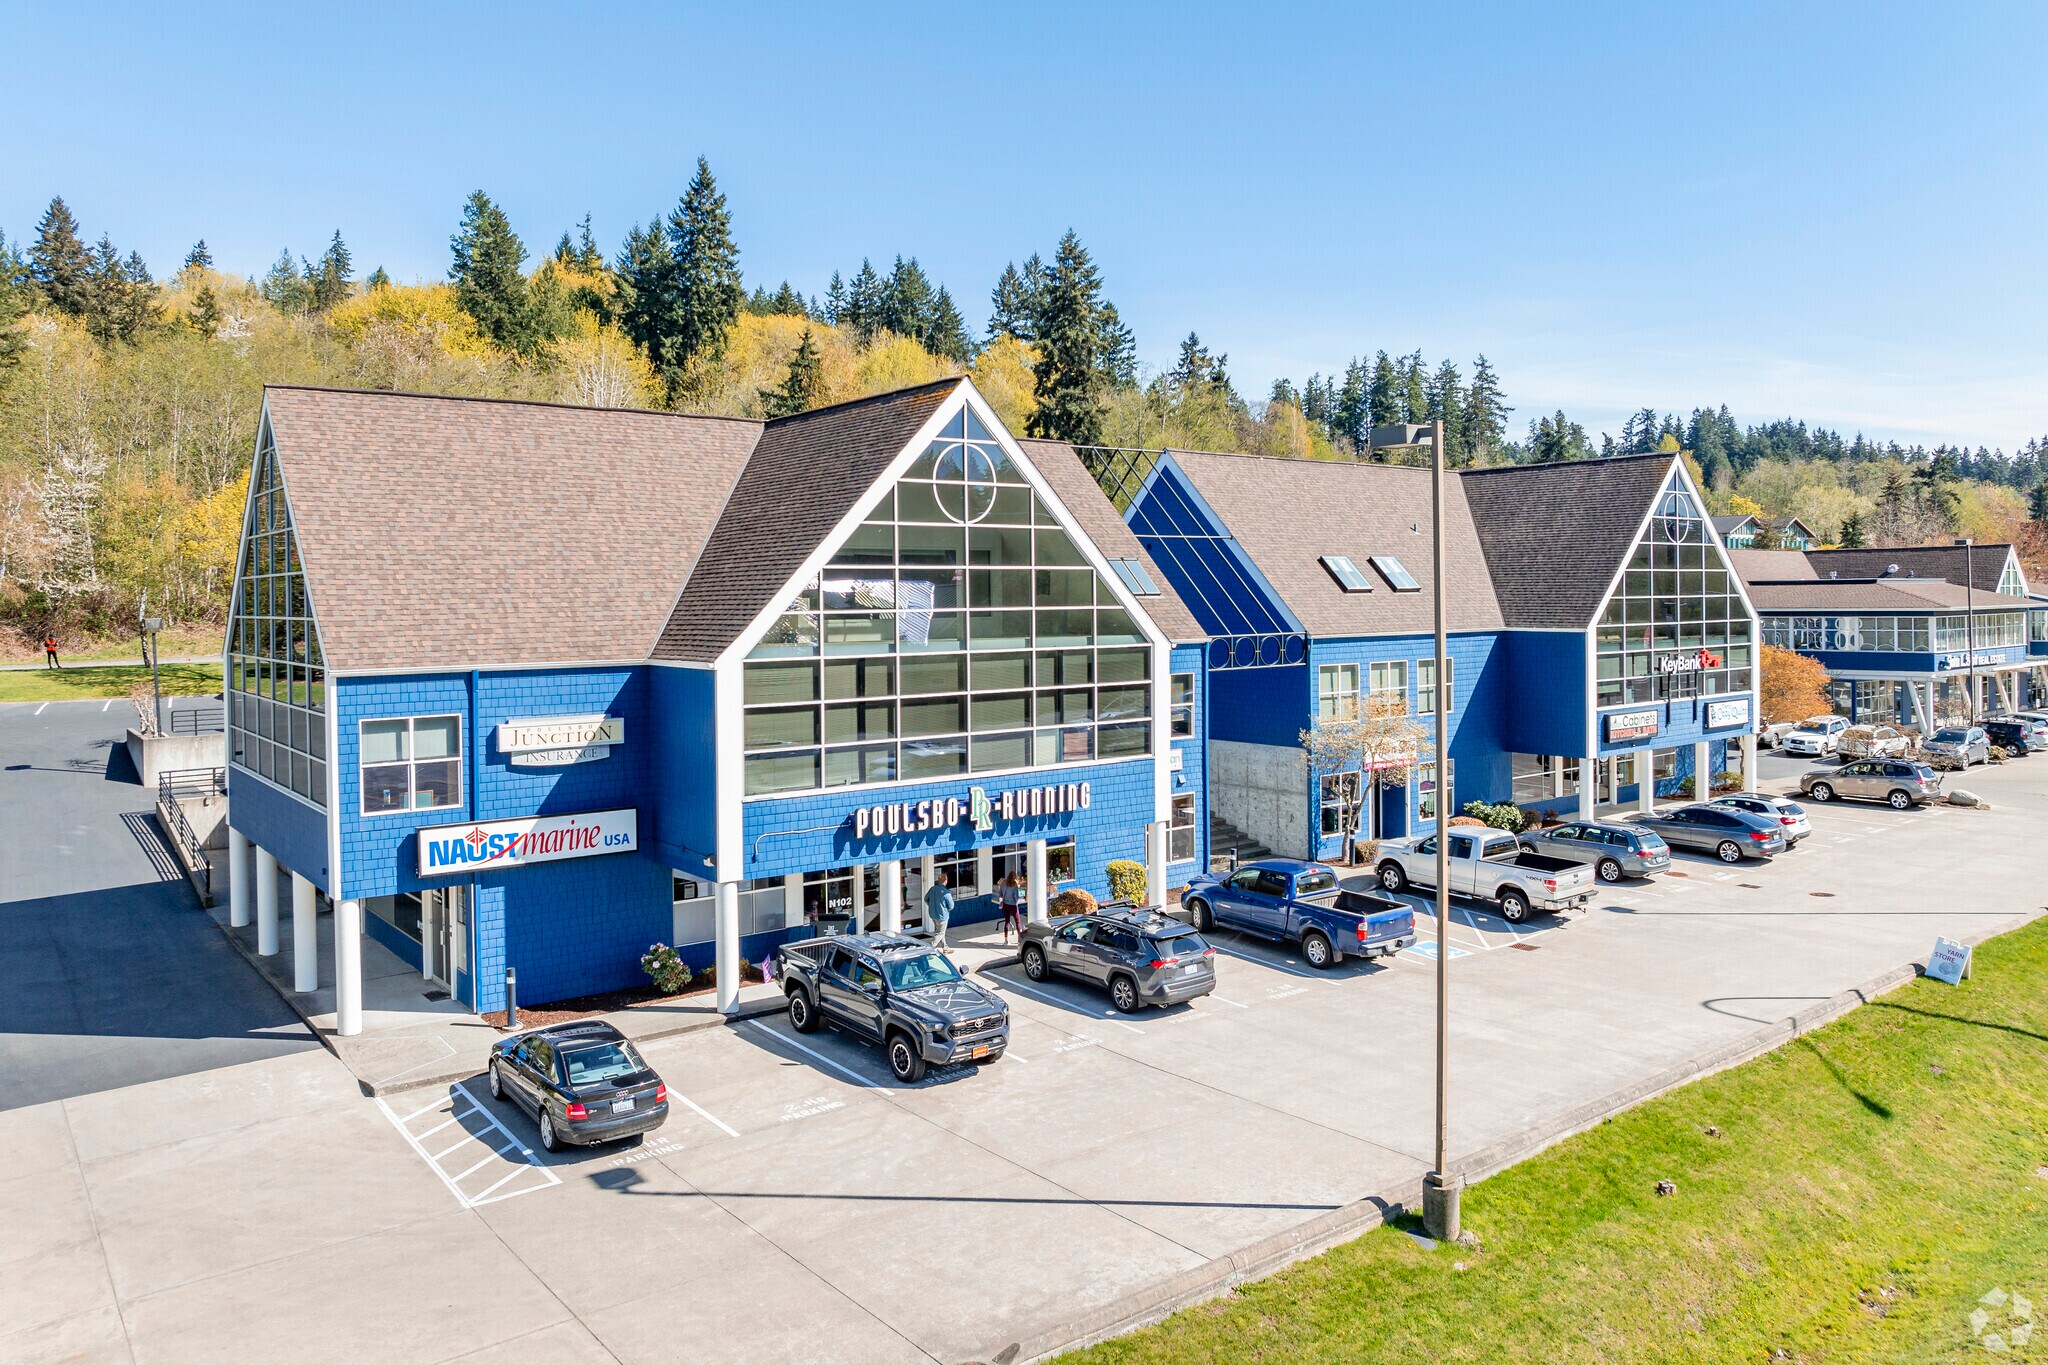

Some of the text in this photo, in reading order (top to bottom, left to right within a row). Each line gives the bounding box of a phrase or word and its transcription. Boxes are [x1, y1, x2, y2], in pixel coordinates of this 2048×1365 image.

[1660, 655, 1702, 675] KeyBank
[1622, 713, 1656, 727] Cabinets
[510, 725, 612, 747] JUNCTION
[525, 748, 599, 763] INSURANCE
[856, 797, 959, 839] POULSBO
[1001, 782, 1092, 820] RUNNING
[429, 819, 630, 868] NAUST marine USA
[829, 897, 852, 908] N102
[1934, 951, 1956, 964] STORE
[1947, 948, 1965, 960] YARN
[644, 1136, 670, 1149] HR
[612, 1142, 685, 1168] PARKING
